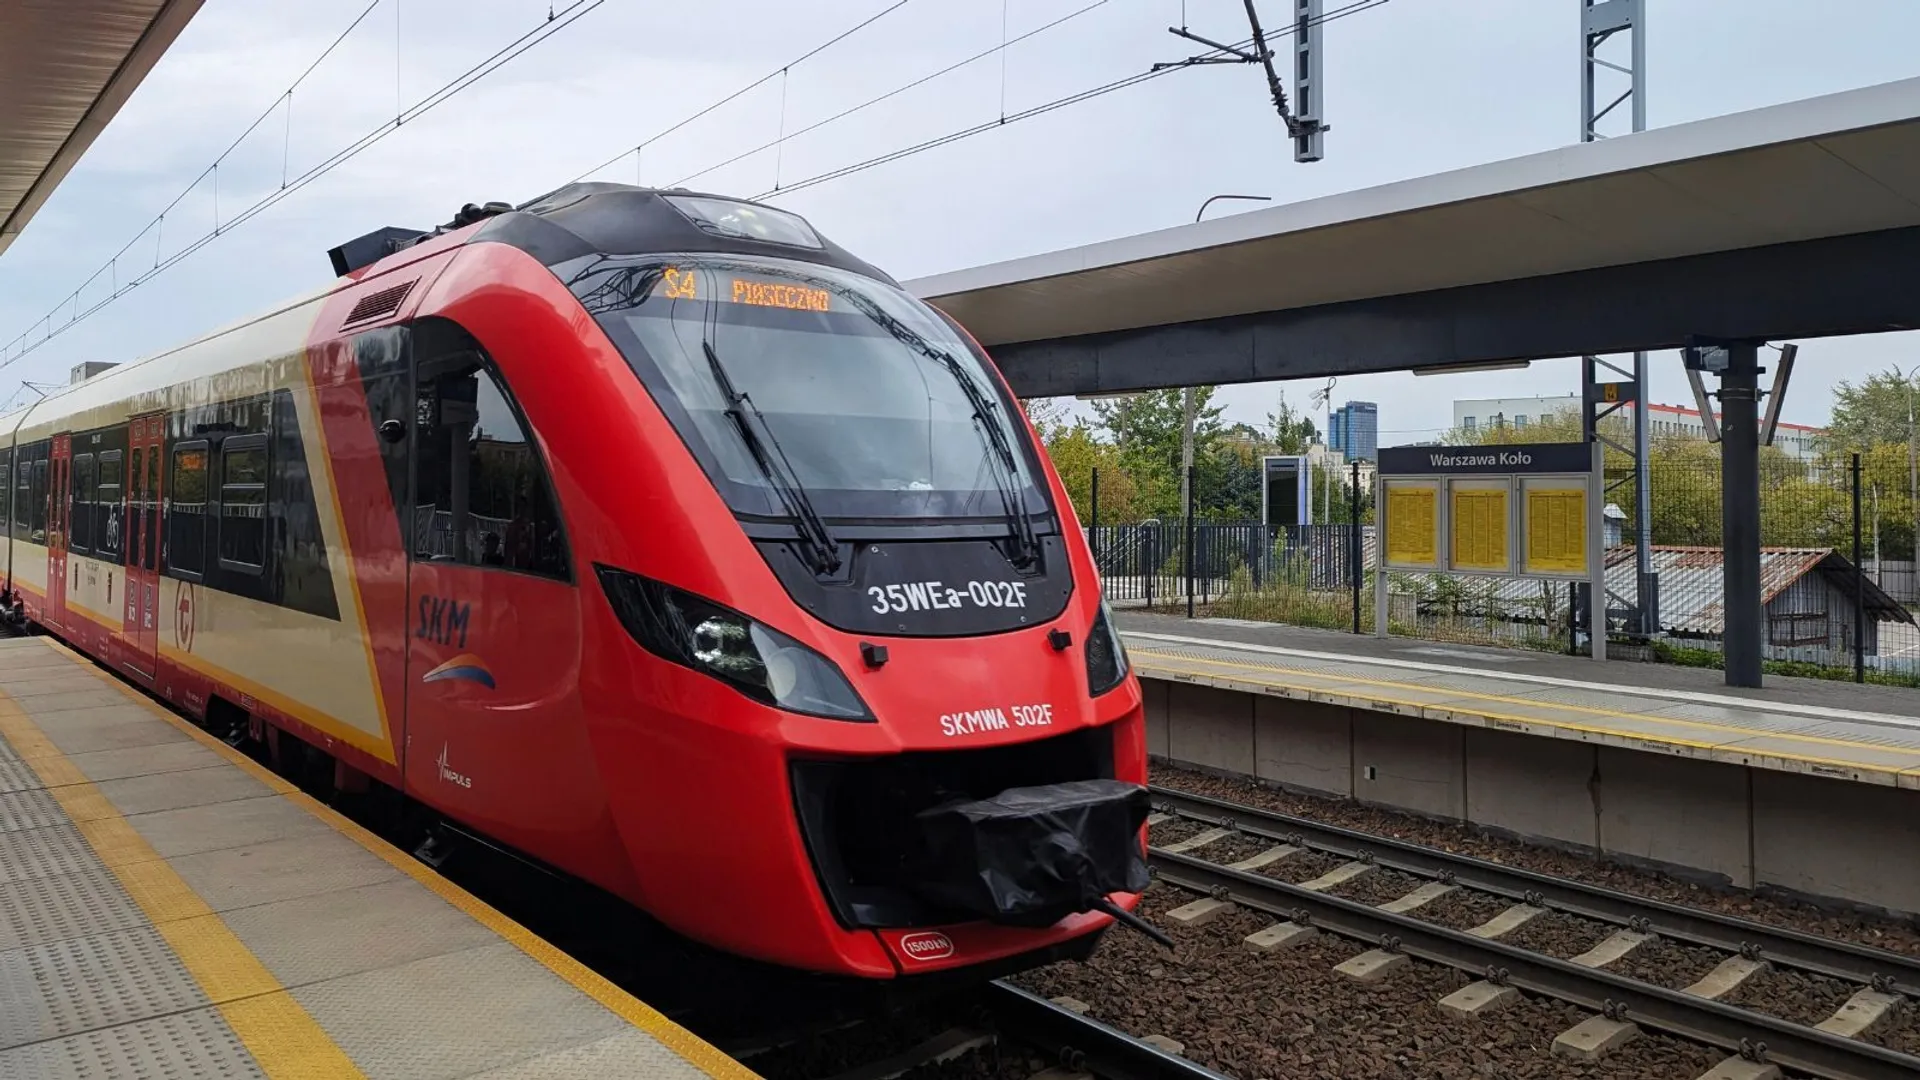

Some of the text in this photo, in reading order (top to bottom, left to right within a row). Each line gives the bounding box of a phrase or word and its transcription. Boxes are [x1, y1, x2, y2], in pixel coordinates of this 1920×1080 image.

[664, 268, 696, 299] S4
[1430, 451, 1532, 467] Warszawa Koło
[868, 581, 1027, 614] 35WEa-002F
[416, 594, 471, 649] SKM
[940, 704, 1053, 736] SKMWA 502F
[443, 767, 472, 788] IMPULS
